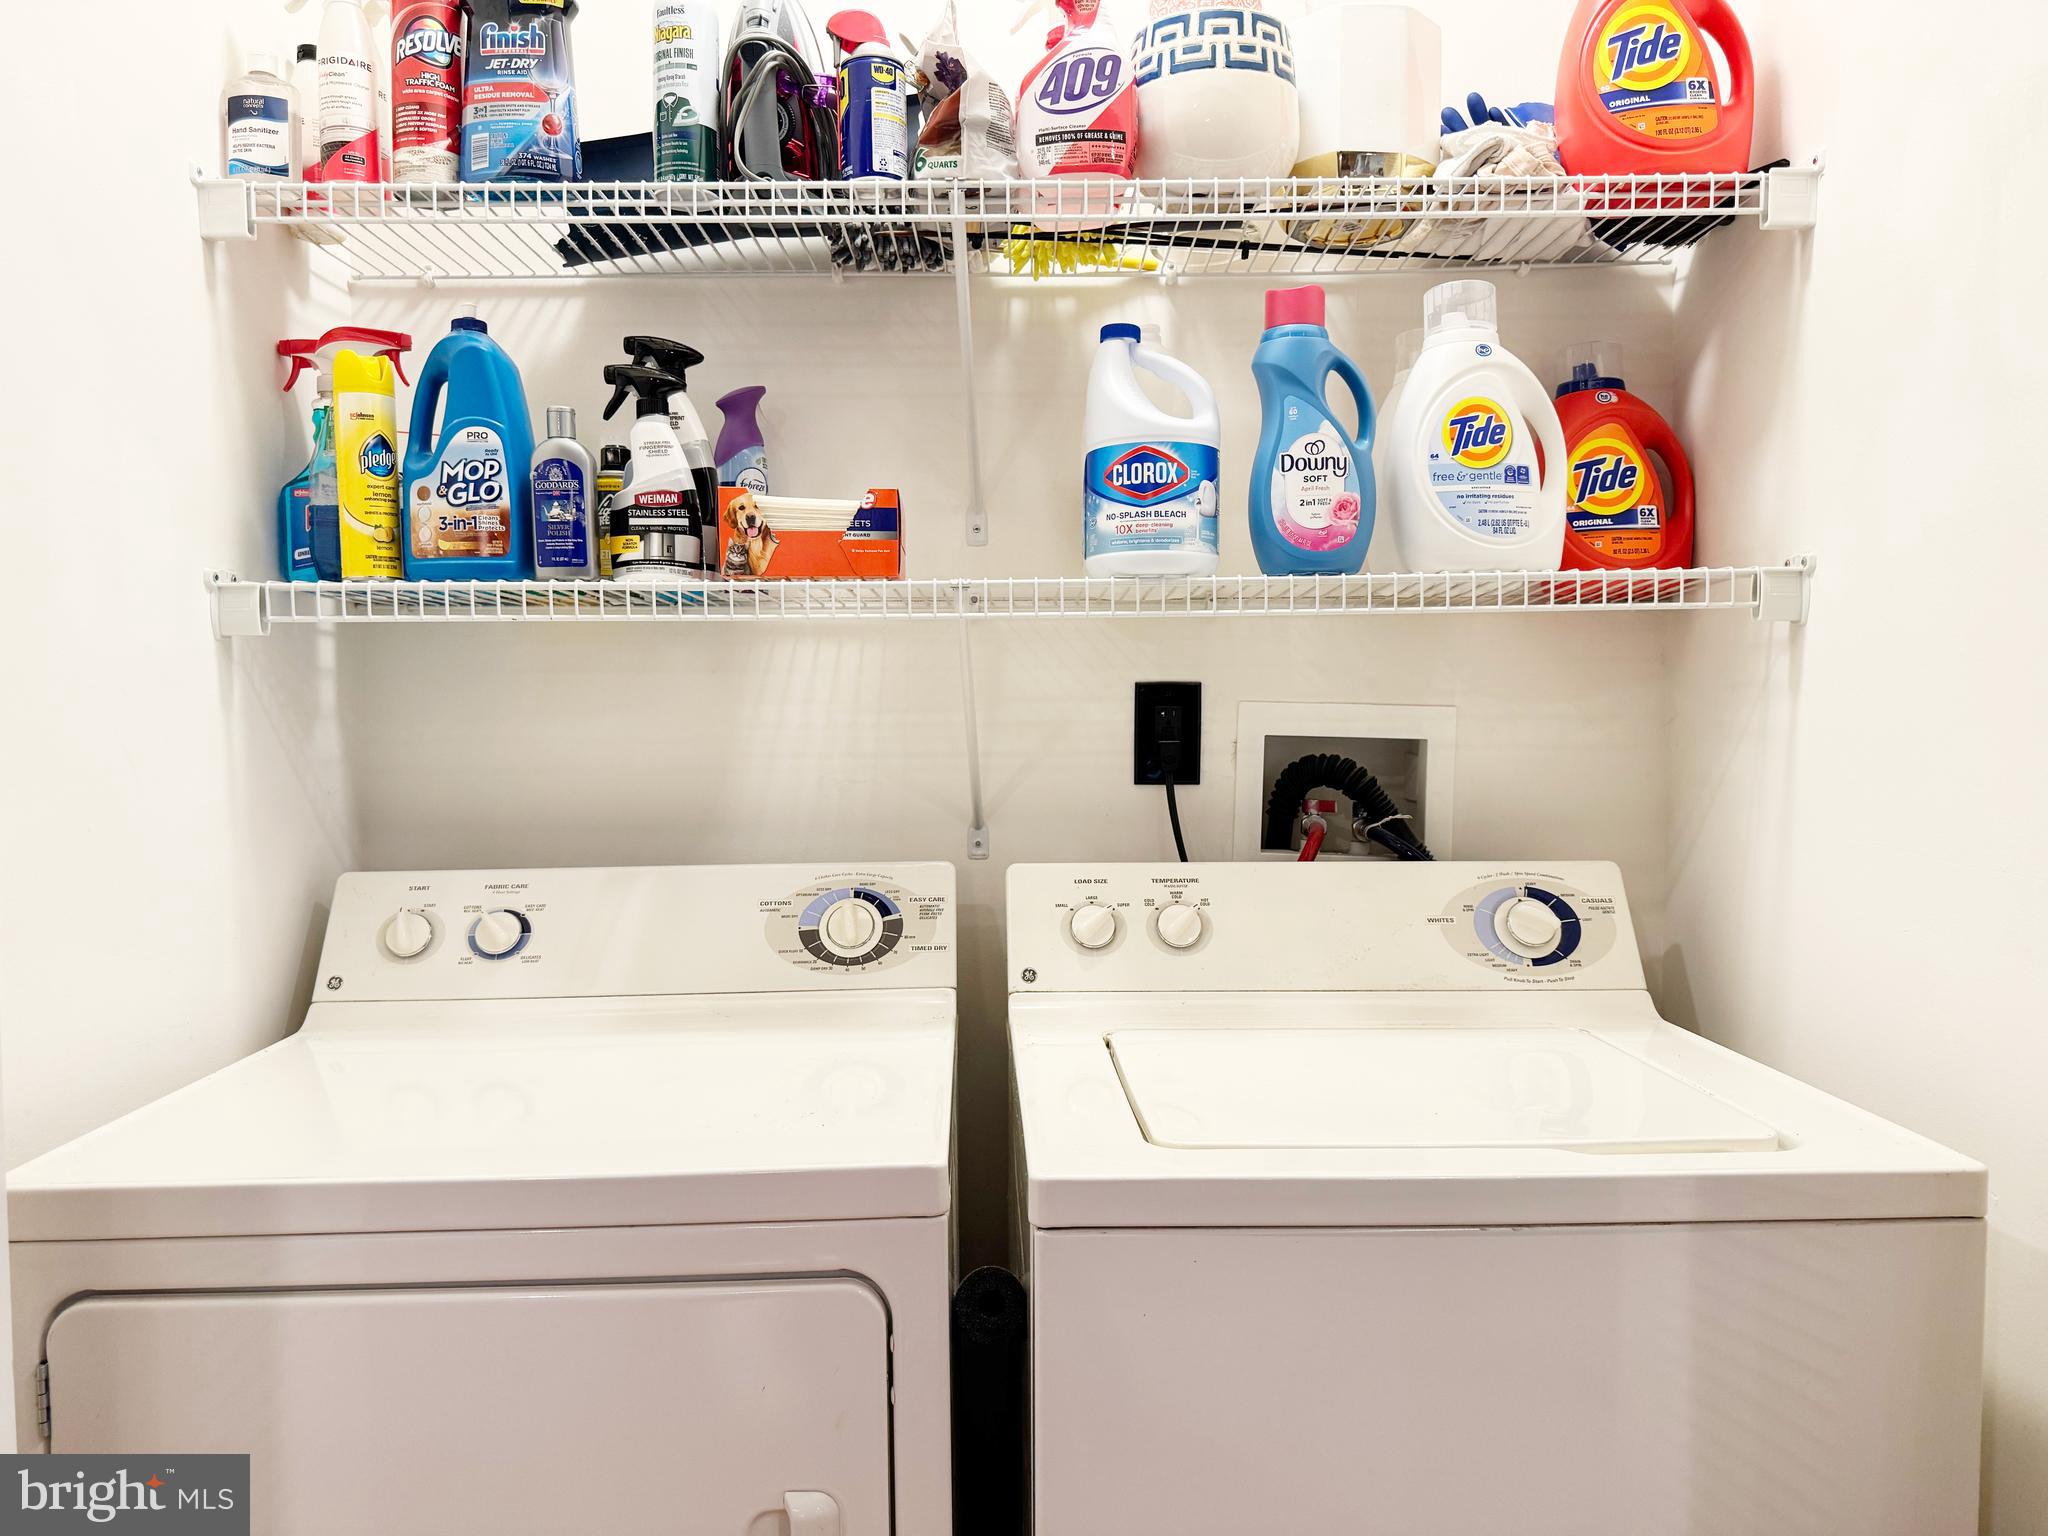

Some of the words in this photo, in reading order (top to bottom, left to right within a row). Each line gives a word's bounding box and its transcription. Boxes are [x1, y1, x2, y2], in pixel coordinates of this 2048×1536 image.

[656, 6, 685, 18] Faultless
[480, 22, 545, 52] finish
[654, 25, 692, 44] Niagara
[395, 29, 461, 65] RESOLVE
[1608, 24, 1682, 81] Tide
[674, 48, 693, 60] FINISH
[486, 58, 538, 70] JET-DRY
[421, 72, 440, 80] HIGH
[874, 66, 893, 76] WD-40
[406, 79, 434, 87] TRAFFIC
[435, 80, 456, 92] FOAM
[1039, 55, 1122, 105] 409
[1688, 81, 1706, 90] 6X
[1609, 96, 1651, 108] ORIGINAL
[248, 127, 280, 136] Sanitizer
[1039, 134, 1061, 143] REMOVES
[1062, 133, 1075, 141] 100%
[1084, 132, 1104, 140] GREASE
[1104, 132, 1109, 140] &
[518, 152, 532, 160] 374
[533, 155, 557, 163] WASHES
[914, 148, 928, 171] 6
[927, 160, 958, 170] QUARTS
[467, 431, 488, 439] PRO
[1449, 414, 1506, 457] Tide
[360, 449, 396, 475] pledge
[1281, 454, 1347, 477] Downy
[442, 459, 501, 483] MOP
[1113, 462, 1178, 486] CLOROX
[1433, 471, 1454, 482] free
[1457, 471, 1467, 482] &
[1468, 471, 1503, 482] gentle
[1573, 457, 1638, 504] Tide
[438, 485, 449, 497] &
[448, 480, 502, 505] GLO
[639, 494, 678, 504] WEIMAN
[1106, 511, 1152, 521] NO-SPLASH
[1154, 510, 1187, 518] BLEACH
[1640, 508, 1654, 517] 6X
[439, 516, 477, 531] 3-in-1
[1573, 518, 1613, 527] ORIGINAL
[1115, 525, 1133, 535] 10X
